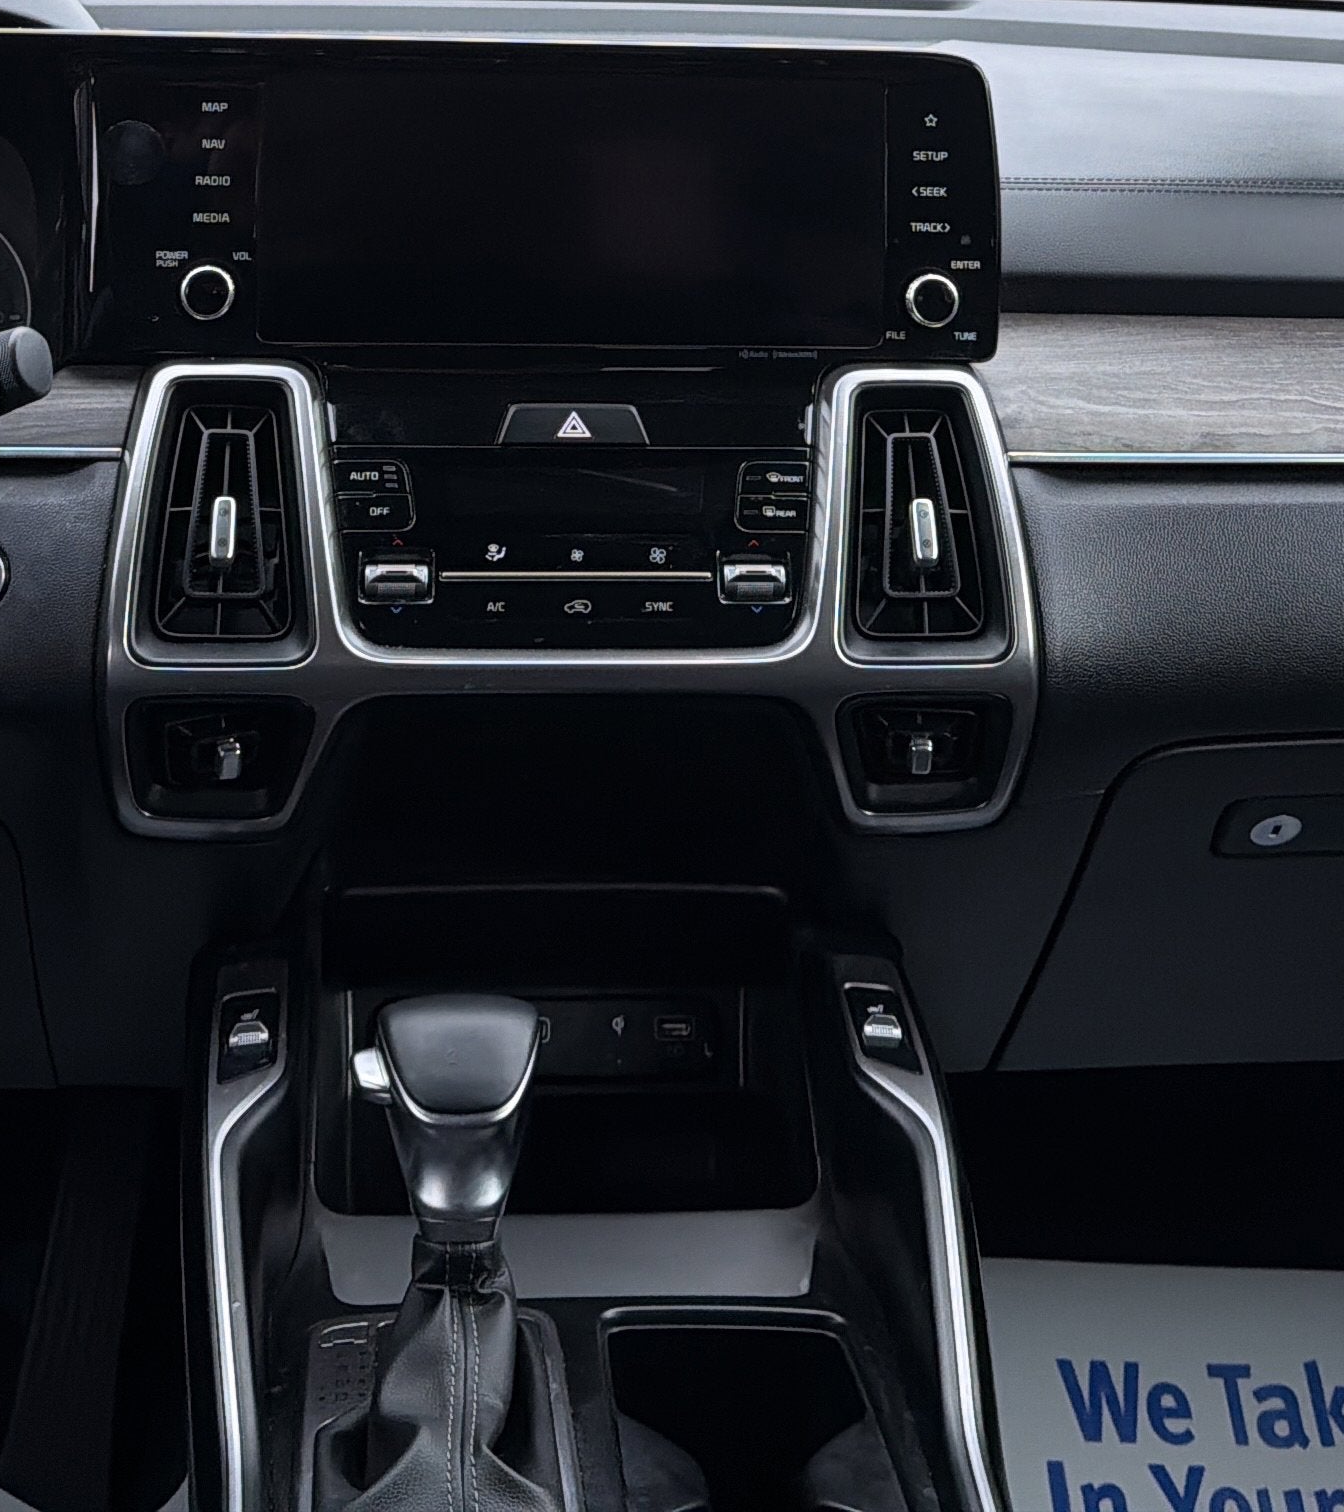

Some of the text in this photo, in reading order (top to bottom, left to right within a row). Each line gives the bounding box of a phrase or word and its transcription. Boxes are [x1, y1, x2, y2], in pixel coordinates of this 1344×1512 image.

[201, 101, 229, 113] MAP
[201, 138, 226, 149] NAV
[912, 151, 949, 162] SETUP
[194, 175, 231, 187] RADIO
[919, 186, 948, 197] SEEK
[192, 212, 231, 224] MEDIA
[910, 222, 944, 233] TRACK
[155, 250, 189, 260] POWER
[232, 251, 253, 261] VOL
[155, 259, 179, 268] PUSH
[950, 260, 981, 270] ENTER
[885, 330, 907, 341] FILE
[952, 331, 978, 342] TUNE
[349, 471, 379, 481] AUTO
[369, 506, 391, 517] OFF
[775, 509, 796, 518] REAR
[486, 601, 506, 613] A/C
[645, 601, 674, 612] SYNC
[1056, 1357, 1196, 1447] We
